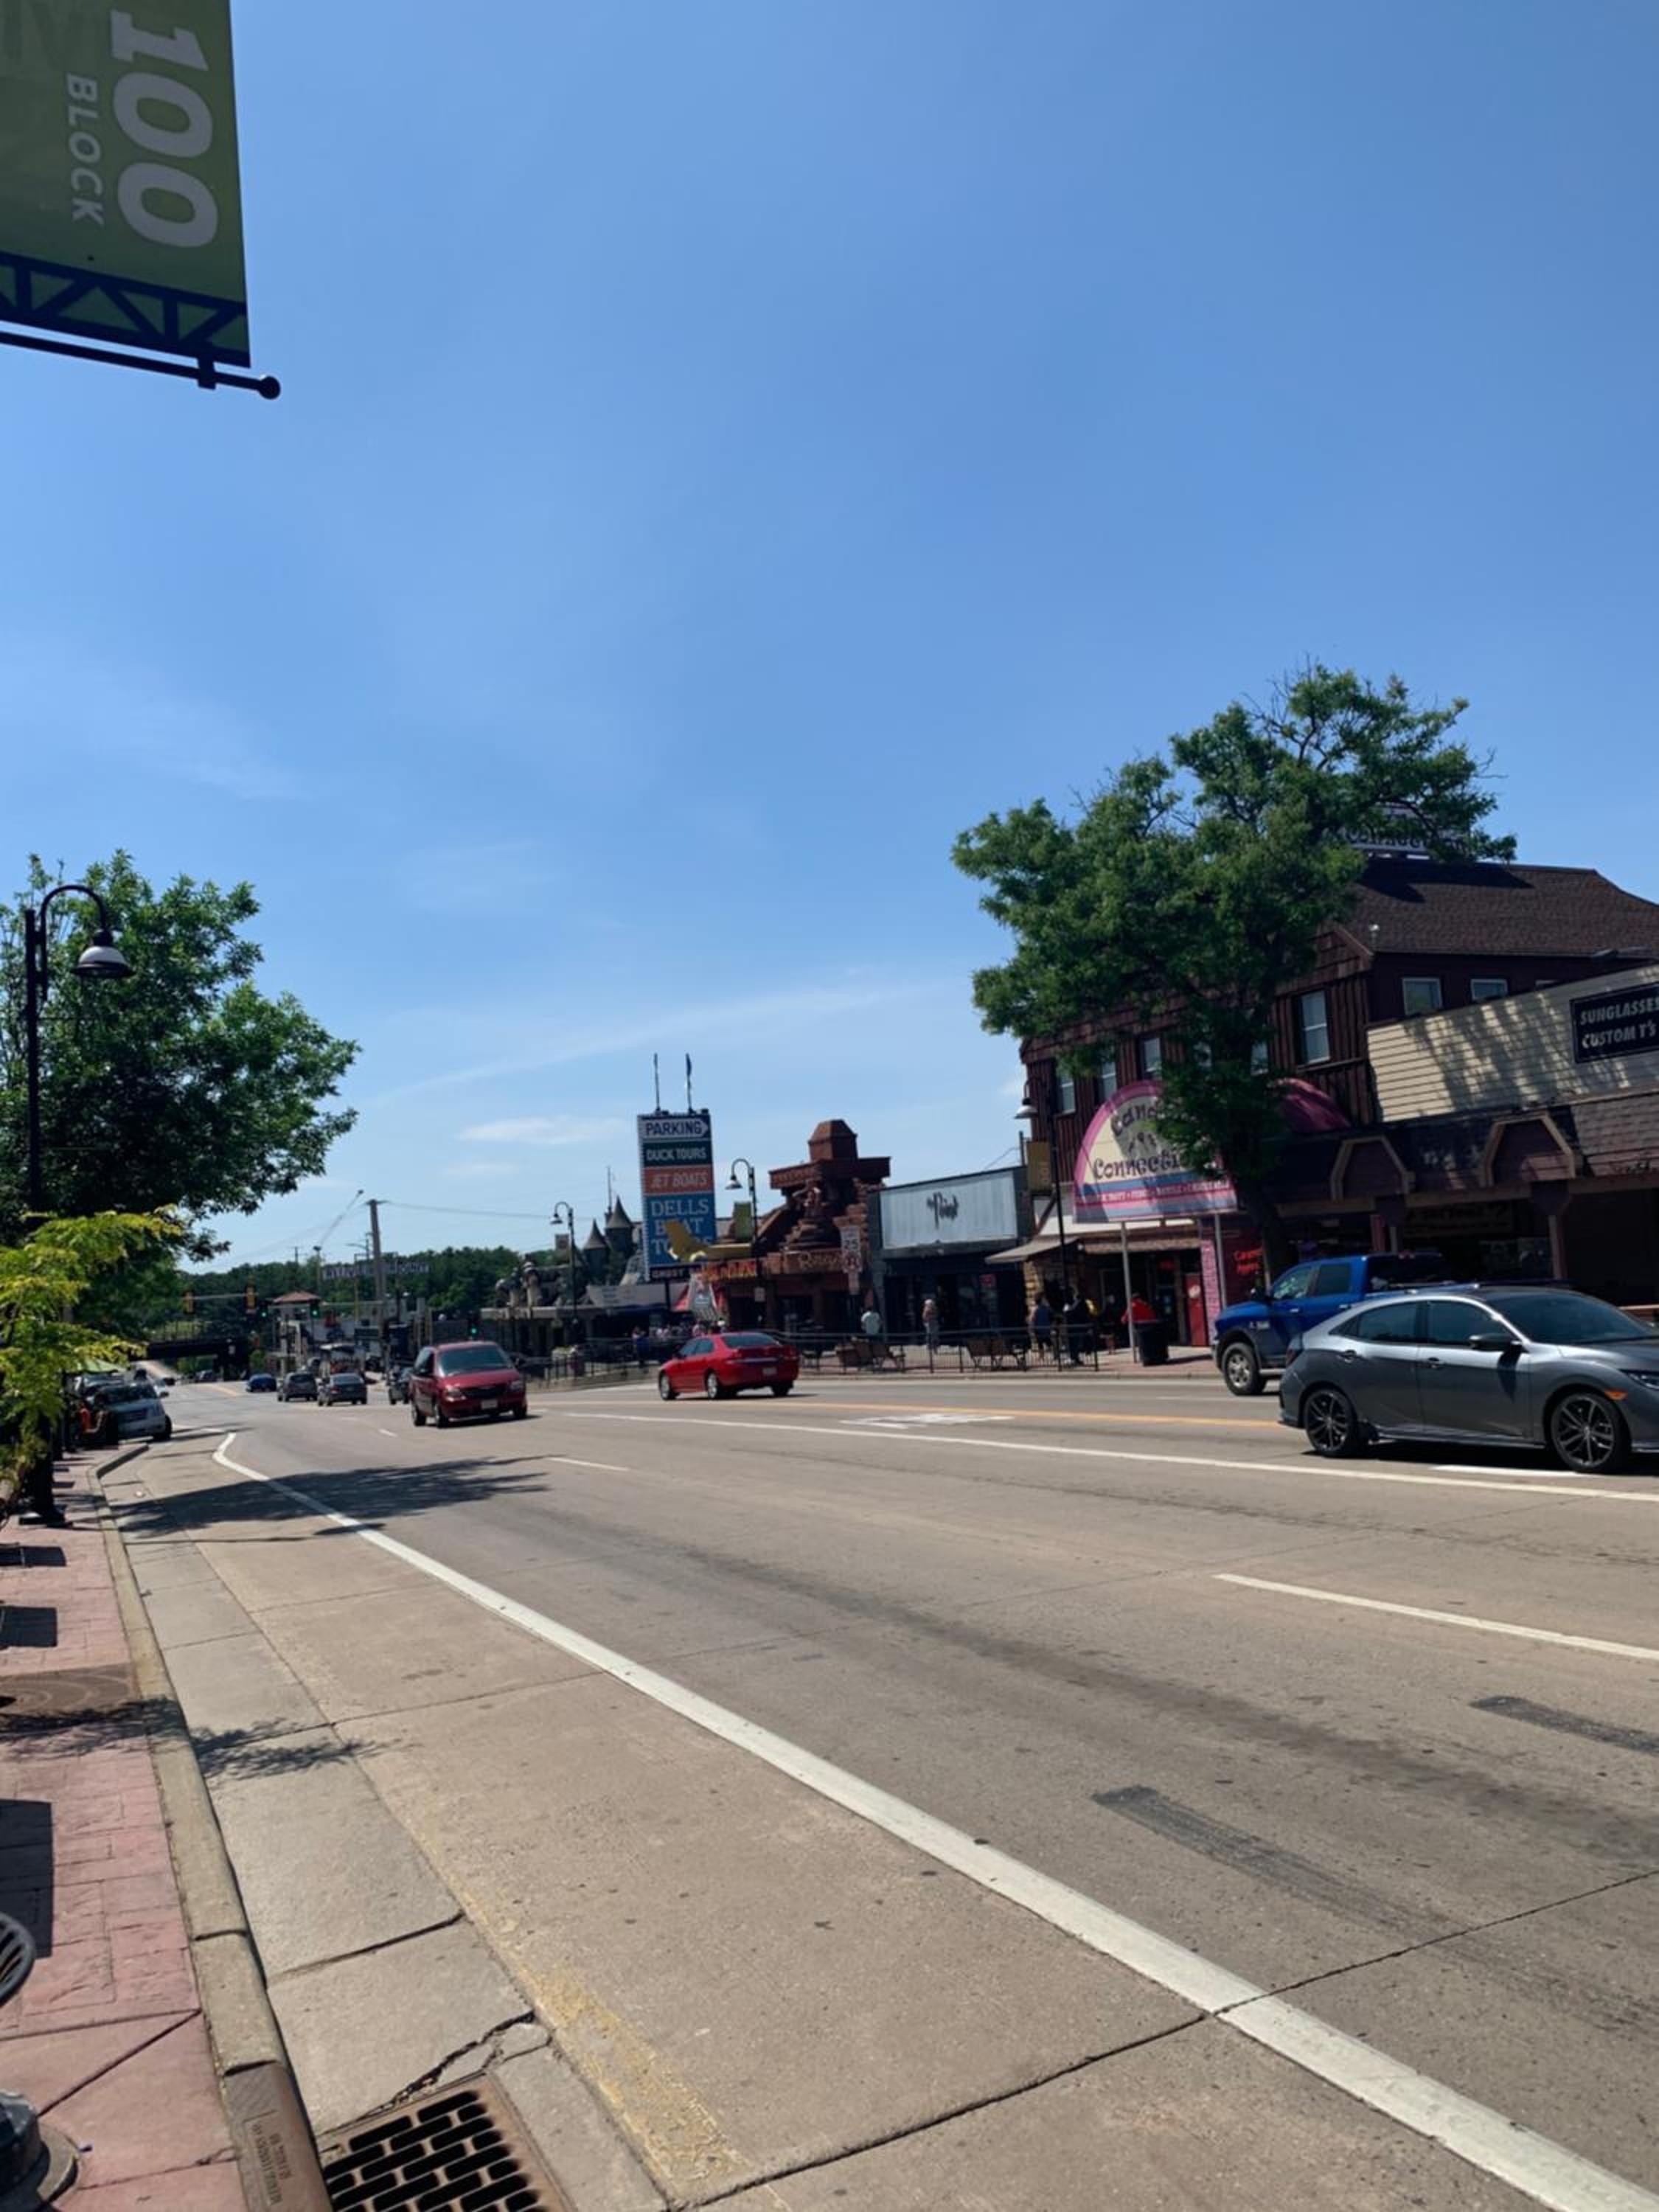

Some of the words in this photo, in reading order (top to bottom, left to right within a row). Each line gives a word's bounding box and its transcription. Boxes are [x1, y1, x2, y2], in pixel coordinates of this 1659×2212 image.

[110, 9, 218, 248] 100
[66, 73, 105, 226] BLOCK
[1582, 1026, 1636, 1048] CUSTOM
[645, 1120, 703, 1136] PARKING
[646, 1150, 674, 1162] DUCK
[676, 1147, 708, 1160] TOURS
[650, 1174, 669, 1189] JET
[672, 1172, 709, 1188] BOATS
[650, 1197, 710, 1217] DELLS
[654, 1217, 705, 1236] BAT
[844, 1238, 859, 1251] 25
